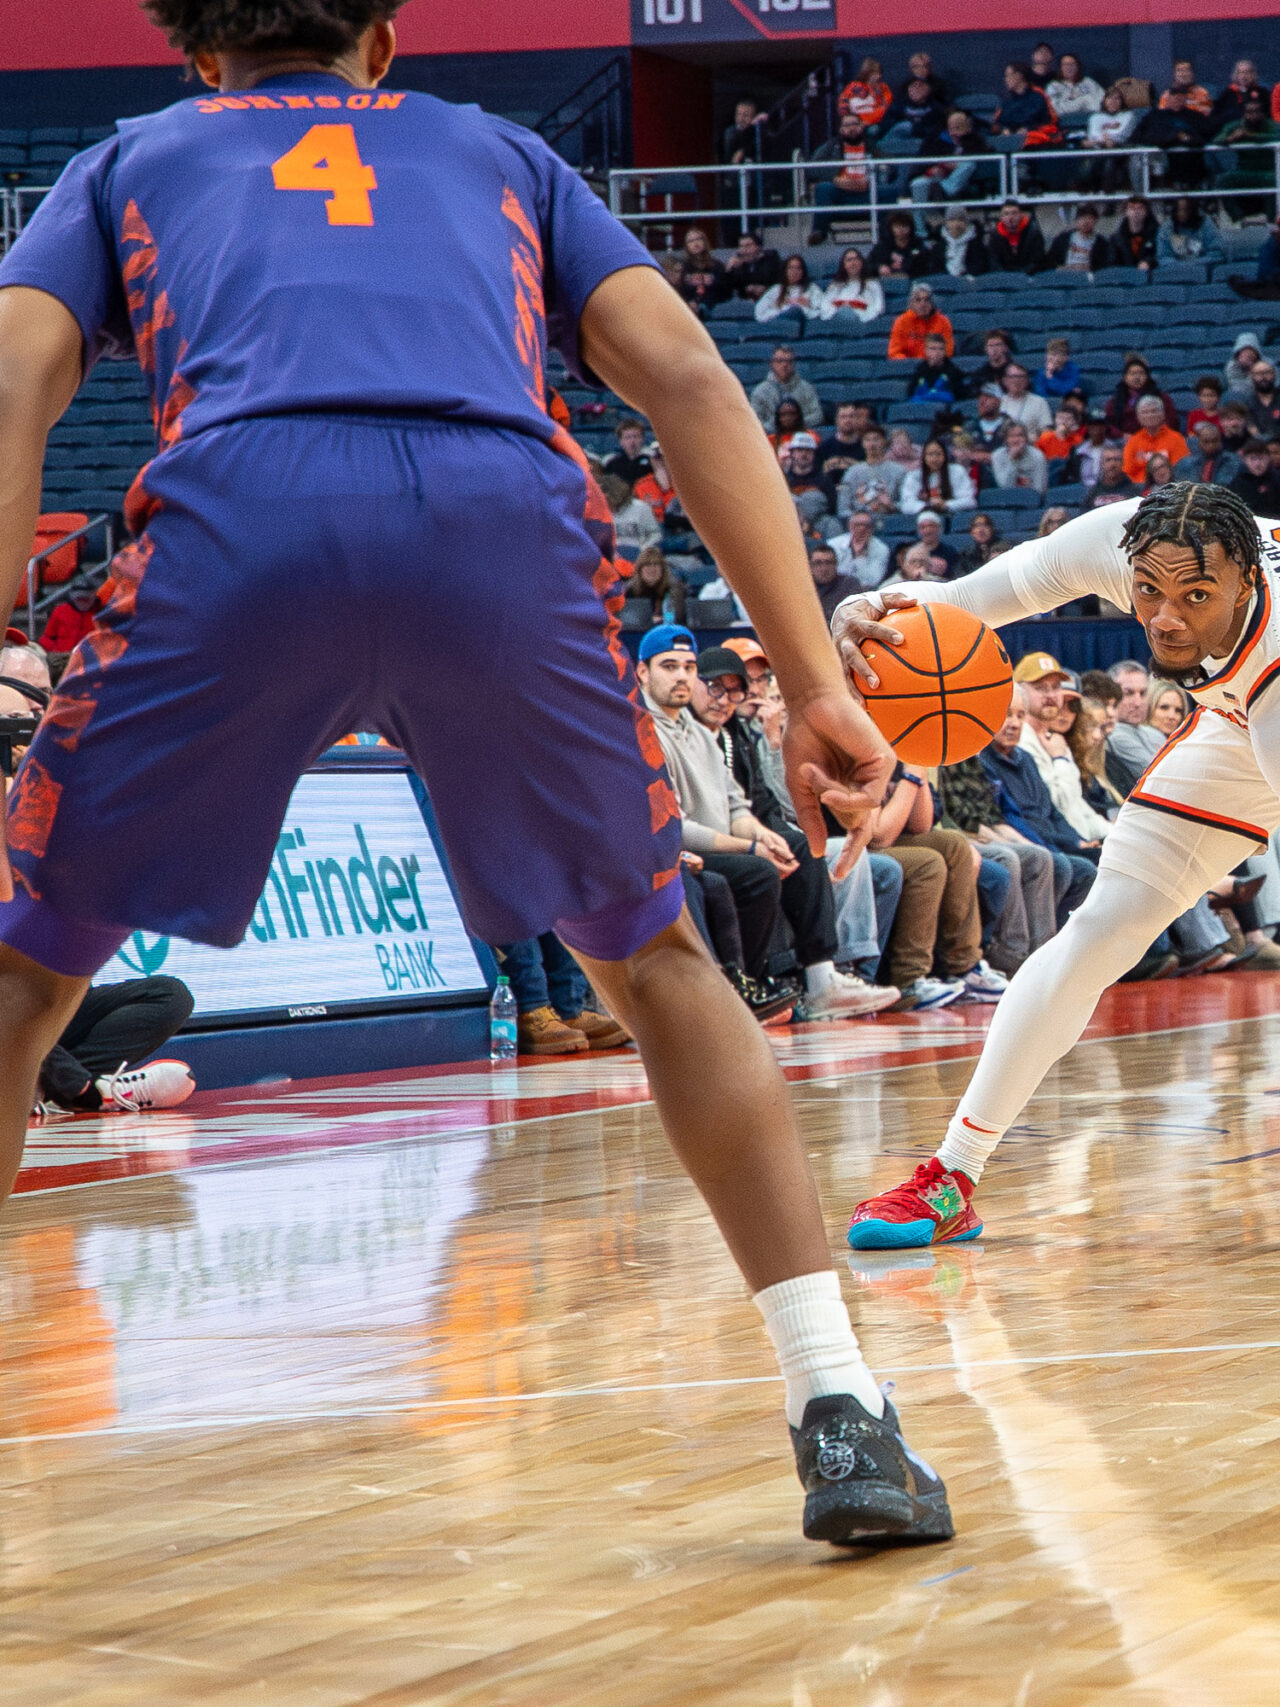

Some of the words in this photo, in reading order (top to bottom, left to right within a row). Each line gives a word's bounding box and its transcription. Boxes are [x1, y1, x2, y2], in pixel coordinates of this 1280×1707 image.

[194, 93, 406, 114] JOHNSON
[271, 123, 378, 226] 4
[375, 941, 447, 990] BANK
